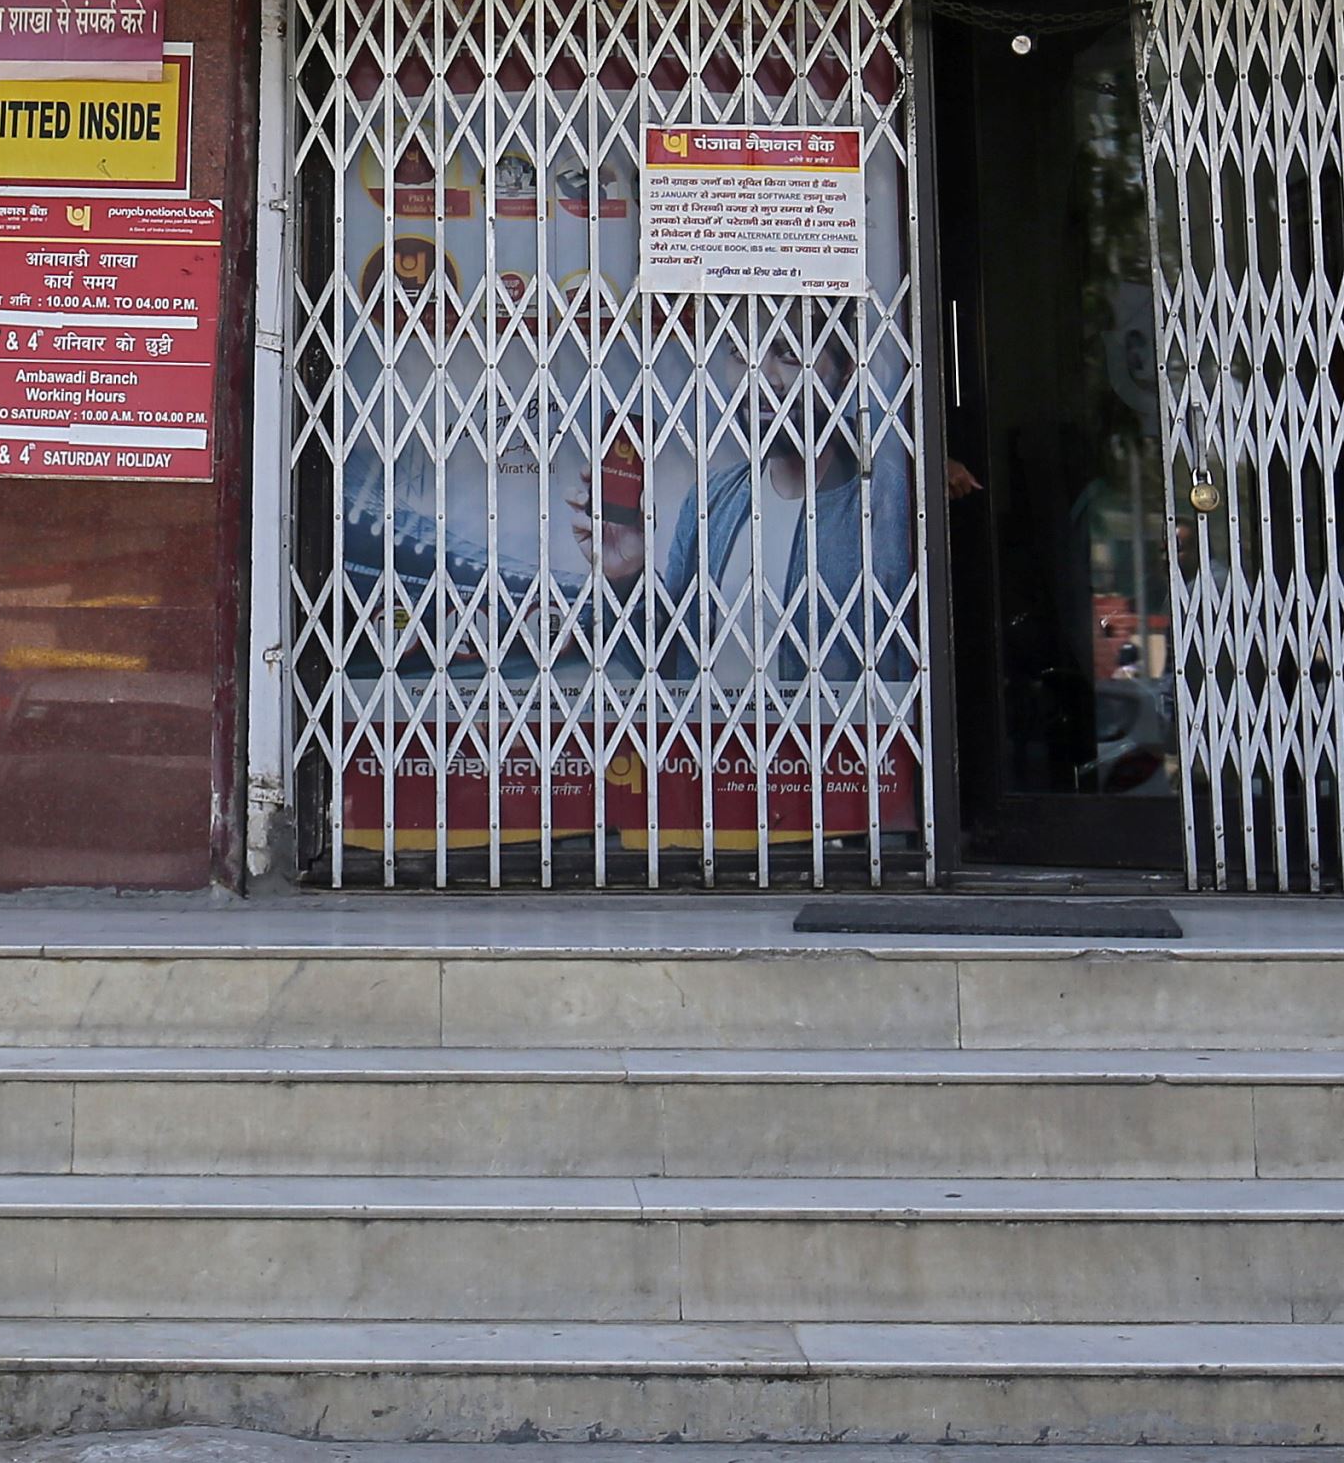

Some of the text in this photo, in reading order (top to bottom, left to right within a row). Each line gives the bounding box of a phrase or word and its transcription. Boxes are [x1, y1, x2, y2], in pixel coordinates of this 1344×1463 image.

[9, 6, 52, 35] शाखा
[78, 102, 161, 140] INSIDE
[758, 192, 801, 200] SOFTWARE
[108, 206, 214, 218] punjab national bank
[25, 248, 138, 268] आंबावाडी शाखा
[44, 271, 117, 290] कार्य समय
[9, 293, 31, 307] शनि
[47, 297, 79, 308] 10.00
[83, 298, 110, 308] A.M.
[114, 298, 131, 309] TO
[136, 298, 169, 310] 04.00
[173, 299, 198, 310] P.M.
[6, 333, 19, 350] &
[53, 334, 105, 352] शनिवार
[116, 334, 135, 352] को
[16, 370, 137, 385] Ambawadi Branch
[26, 388, 126, 405] Working Hours
[11, 409, 71, 420] SATURDAY
[81, 410, 108, 421] 10.00
[111, 411, 134, 422] A.M.
[137, 412, 152, 423] TO
[155, 412, 183, 423] 04.00
[186, 413, 207, 424] P.M.
[44, 452, 110, 466] SATURDAY
[117, 453, 172, 468] HOLIDAY
[498, 463, 555, 474] Virat Koli
[826, 782, 858, 793] BANK
